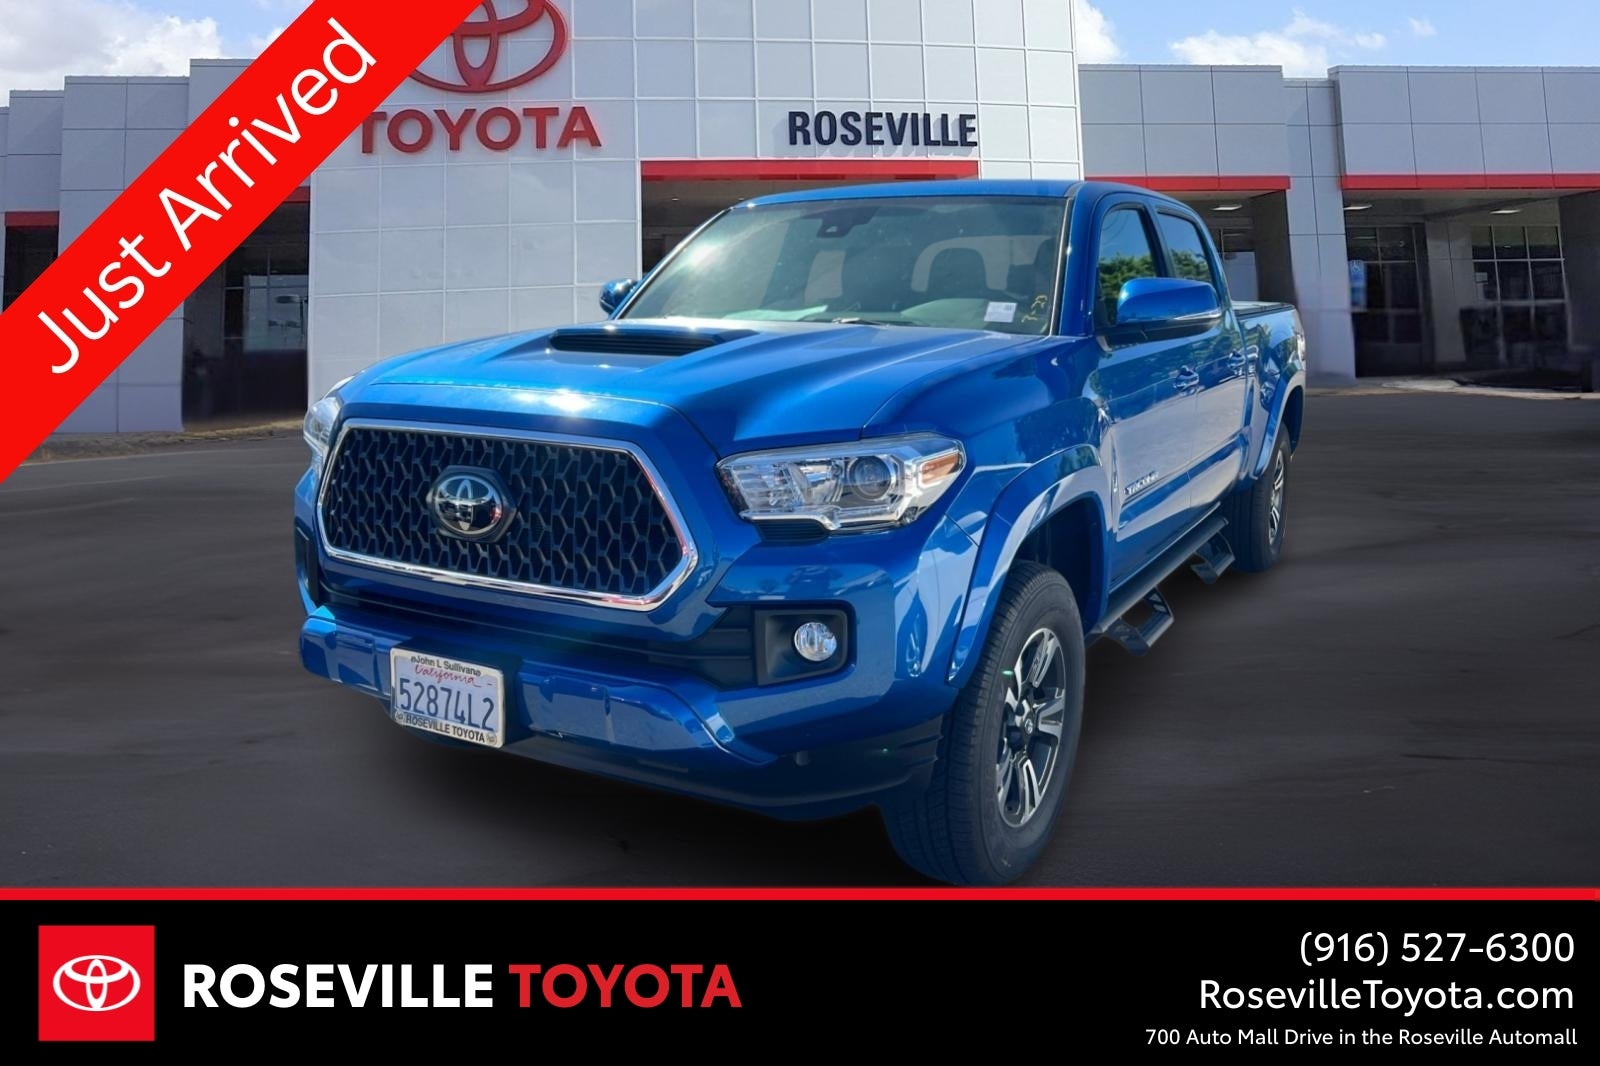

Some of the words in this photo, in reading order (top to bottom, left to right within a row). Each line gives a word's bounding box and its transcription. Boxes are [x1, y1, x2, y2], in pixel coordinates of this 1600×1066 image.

[361, 106, 602, 154] TOYOTA
[788, 110, 978, 147] ROSEVILLE
[443, 660, 477, 676] Sullivan
[399, 677, 495, 732] 52874L2
[452, 725, 485, 743] TOYOTA
